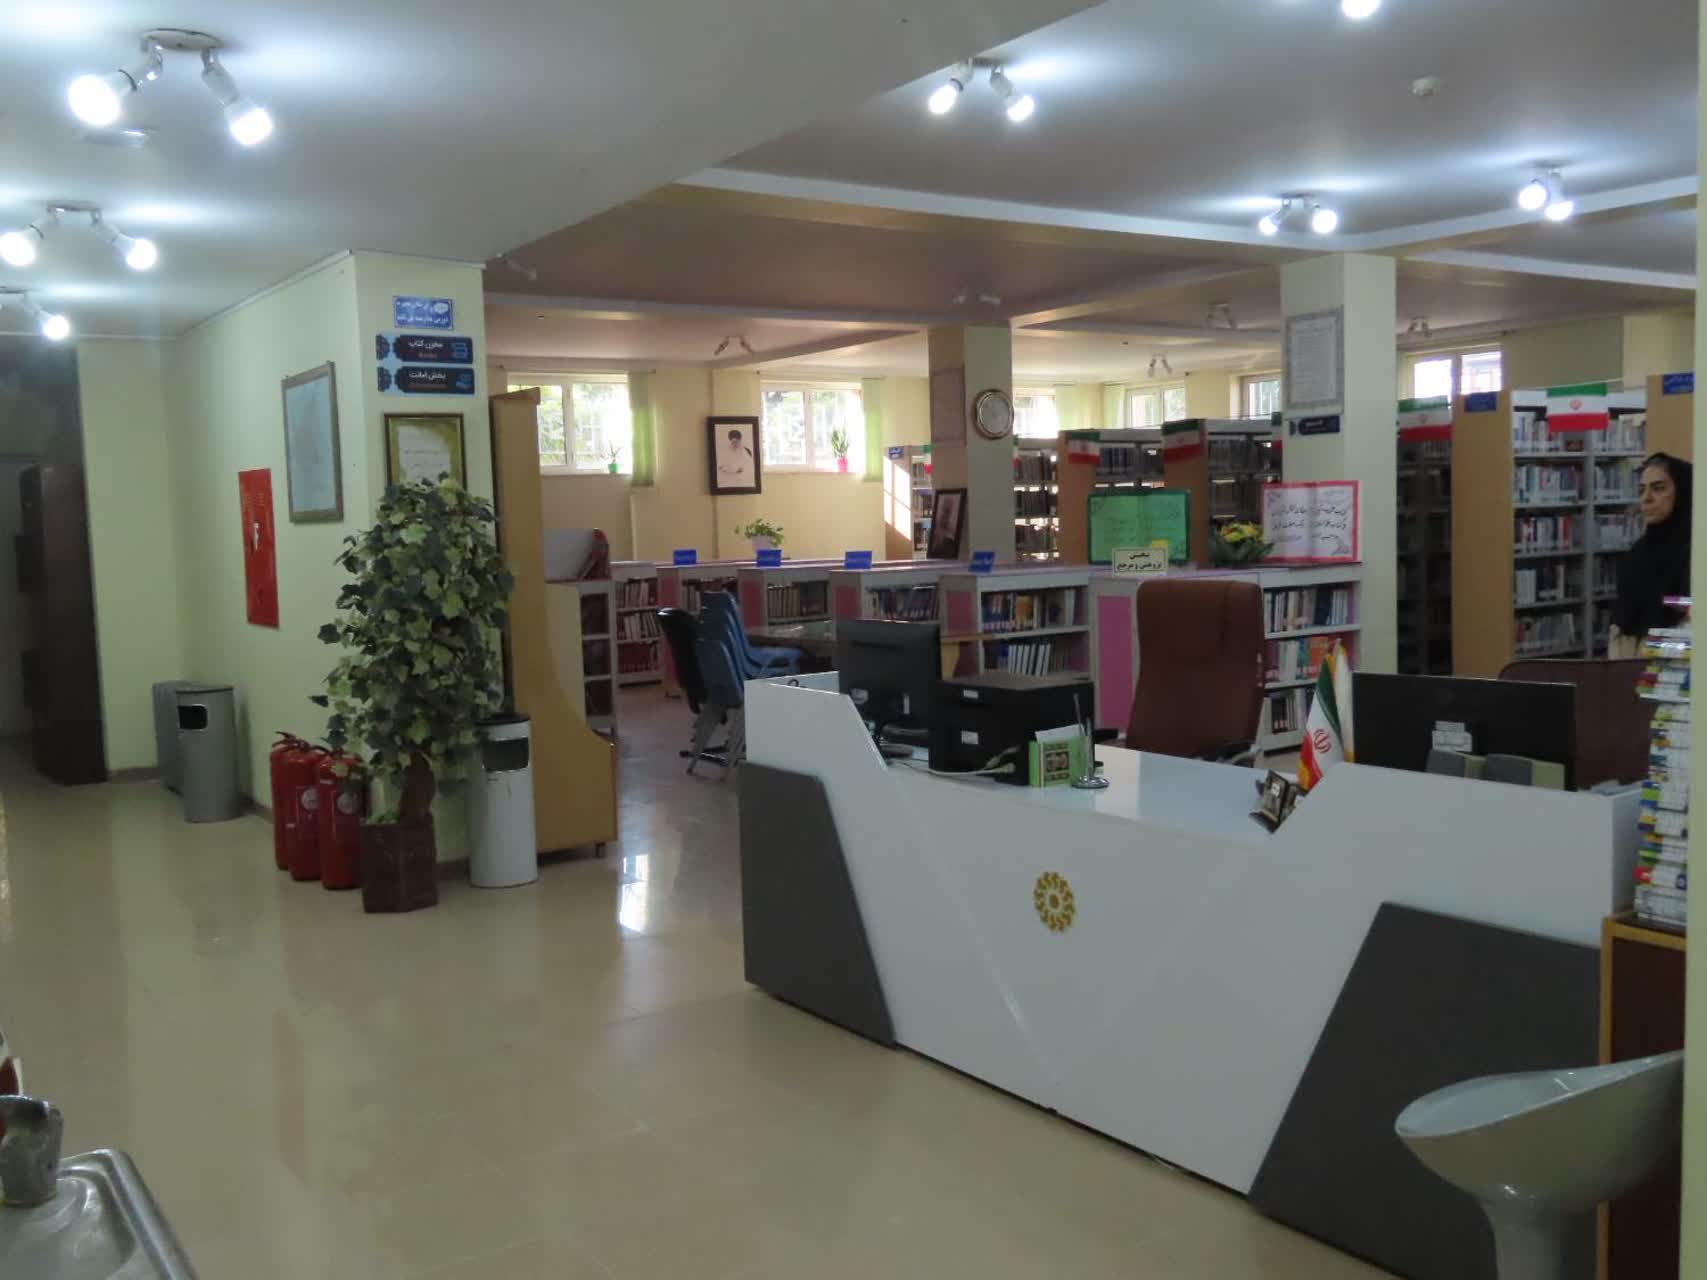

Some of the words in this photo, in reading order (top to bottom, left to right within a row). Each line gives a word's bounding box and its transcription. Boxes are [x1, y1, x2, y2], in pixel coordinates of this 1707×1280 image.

[408, 339, 425, 349] کتاب
[408, 370, 428, 379] امانت
[428, 371, 446, 381] بخش
